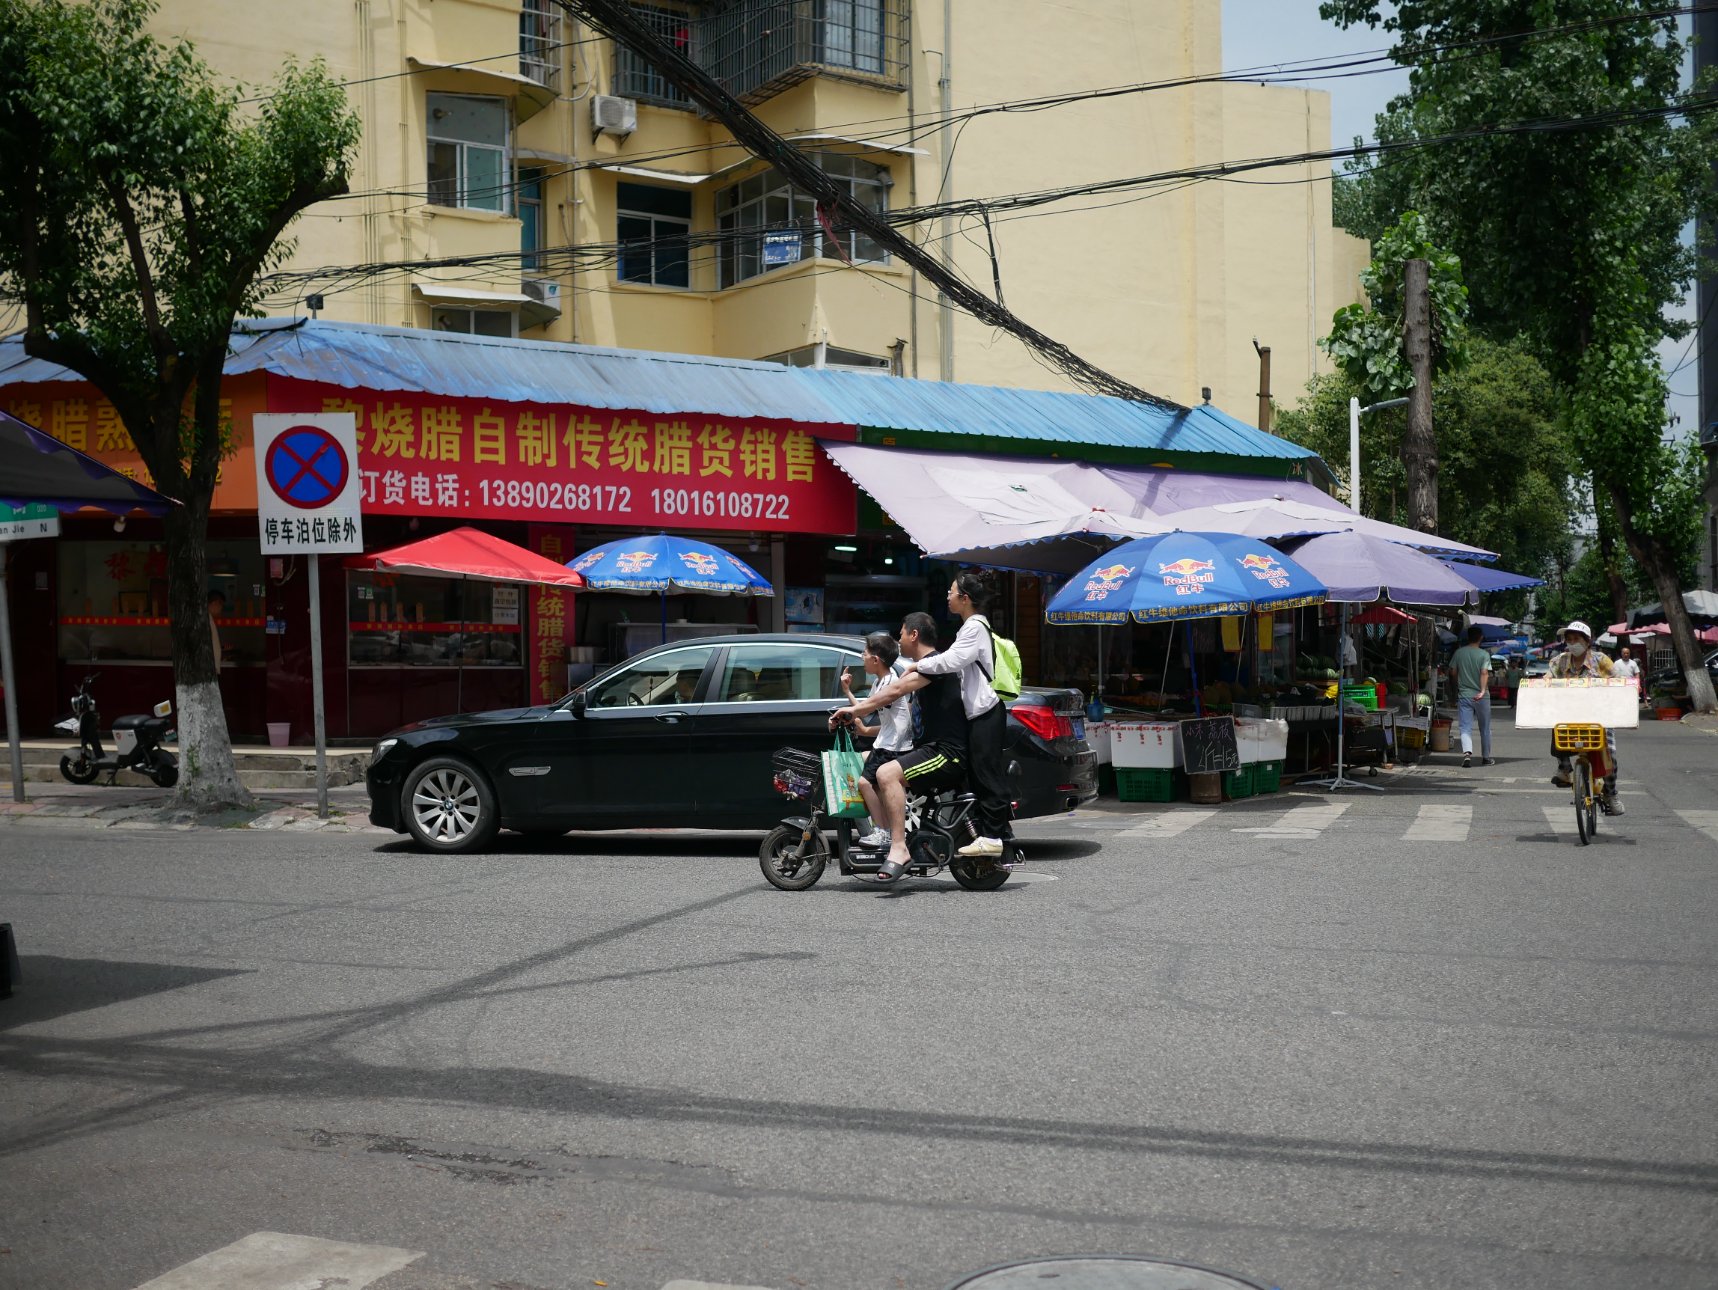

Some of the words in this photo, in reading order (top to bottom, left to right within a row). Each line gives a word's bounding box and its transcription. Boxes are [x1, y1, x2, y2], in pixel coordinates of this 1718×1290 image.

[651, 487, 790, 520] 18016108722
[12, 525, 25, 534] Jie
[40, 523, 48, 532] N
[265, 516, 356, 545] 停车泊位除外
[1083, 580, 1123, 591] RedBull
[1163, 573, 1214, 586] RedBull
[1085, 590, 1109, 601] 红牛
[1176, 584, 1205, 596] 红牛
[1138, 602, 1249, 619] 红牛维他命饮料有限公司
